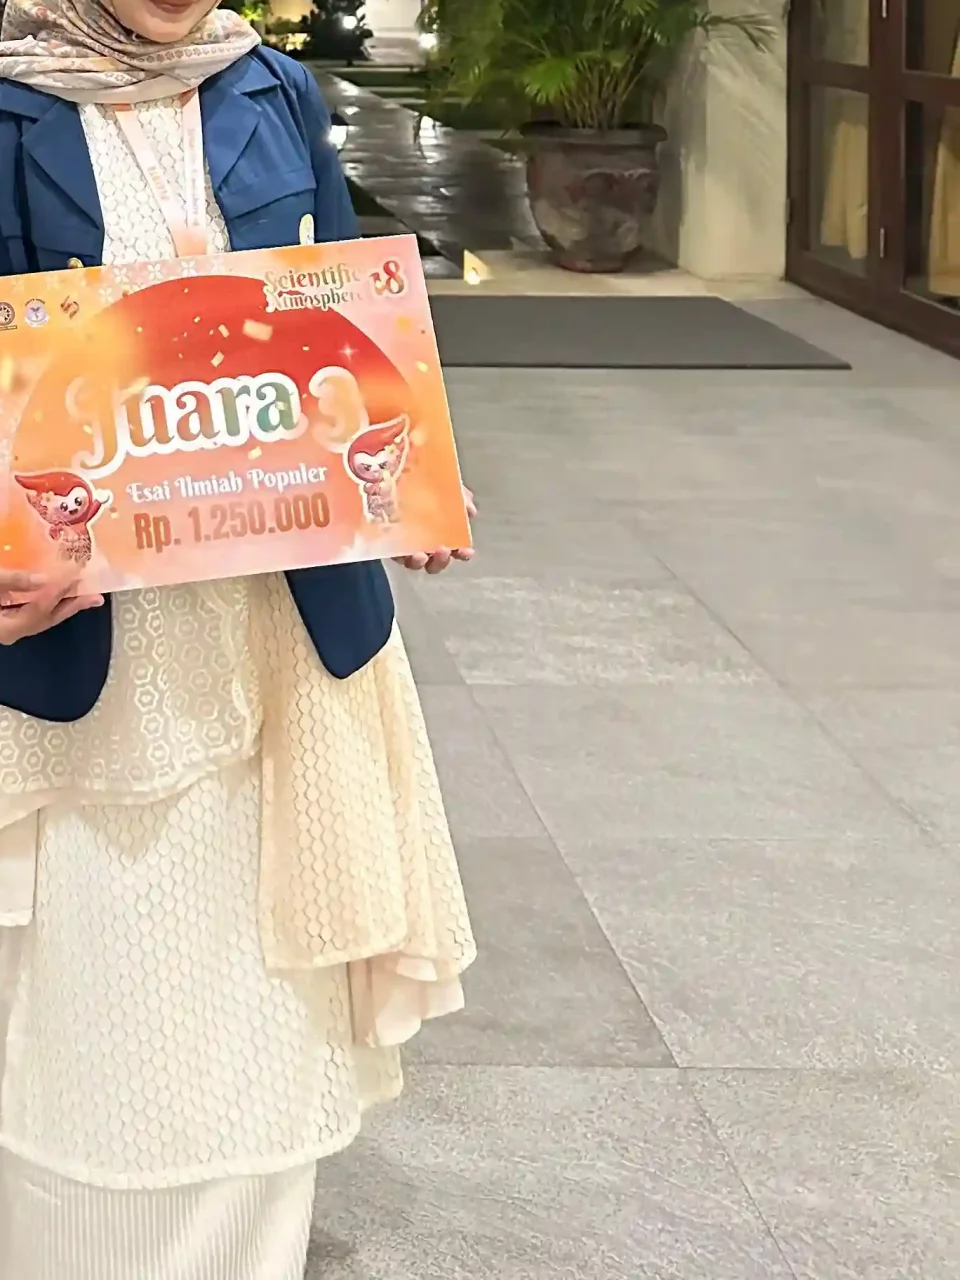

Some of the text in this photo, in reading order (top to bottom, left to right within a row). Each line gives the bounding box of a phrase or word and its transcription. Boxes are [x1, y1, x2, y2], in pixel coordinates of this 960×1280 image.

[264, 263, 360, 293] Scientific
[67, 366, 368, 476] Juara 3
[125, 463, 328, 504] Esai Ilmiah Populer
[133, 492, 331, 554] Rp. 1.250.000
